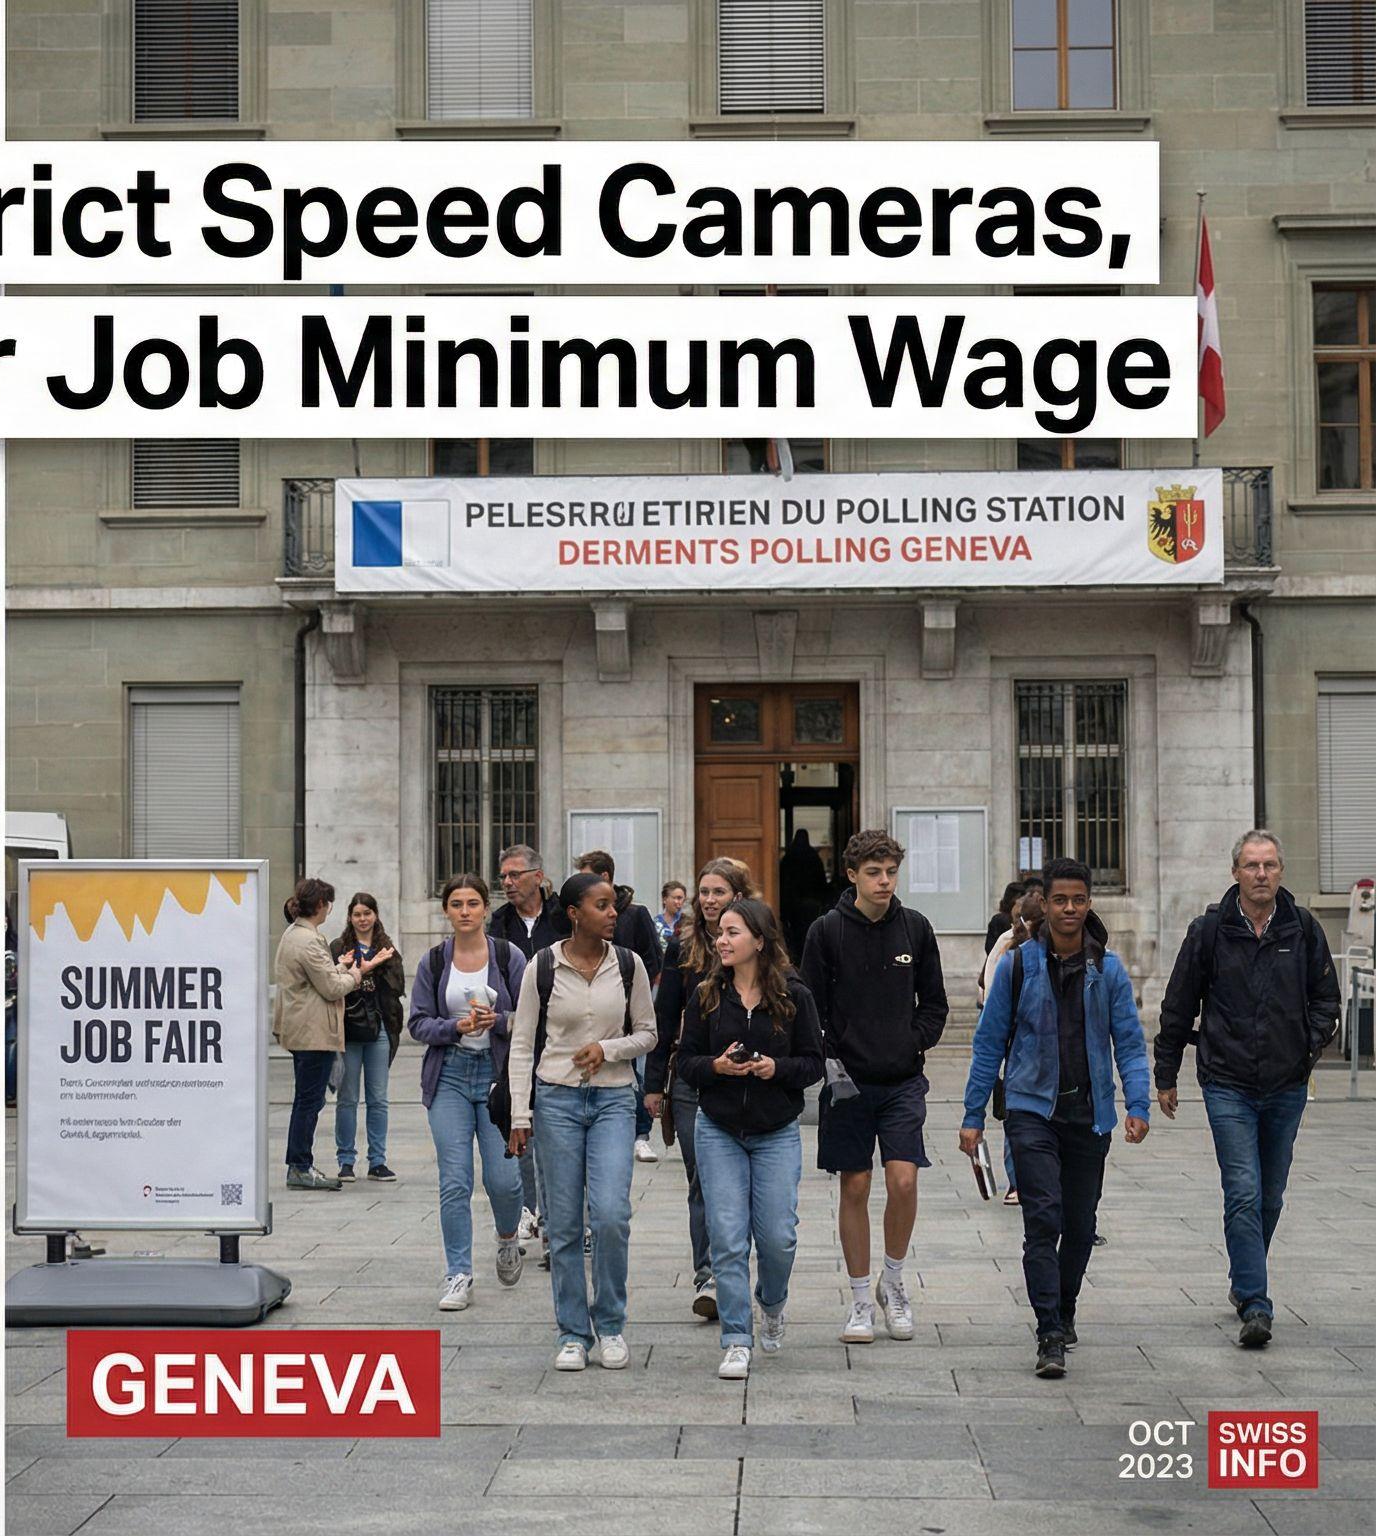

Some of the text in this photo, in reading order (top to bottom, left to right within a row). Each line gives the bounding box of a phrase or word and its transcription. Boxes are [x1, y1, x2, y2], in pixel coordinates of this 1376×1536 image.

[782, 499, 825, 525] DU
[836, 497, 977, 524] POLLING
[986, 495, 1124, 522] STATION
[558, 535, 1032, 566] DERMENTS POLLING GENEVA
[60, 965, 223, 1011] SUMMER
[60, 1020, 223, 1064] JOB FAIR
